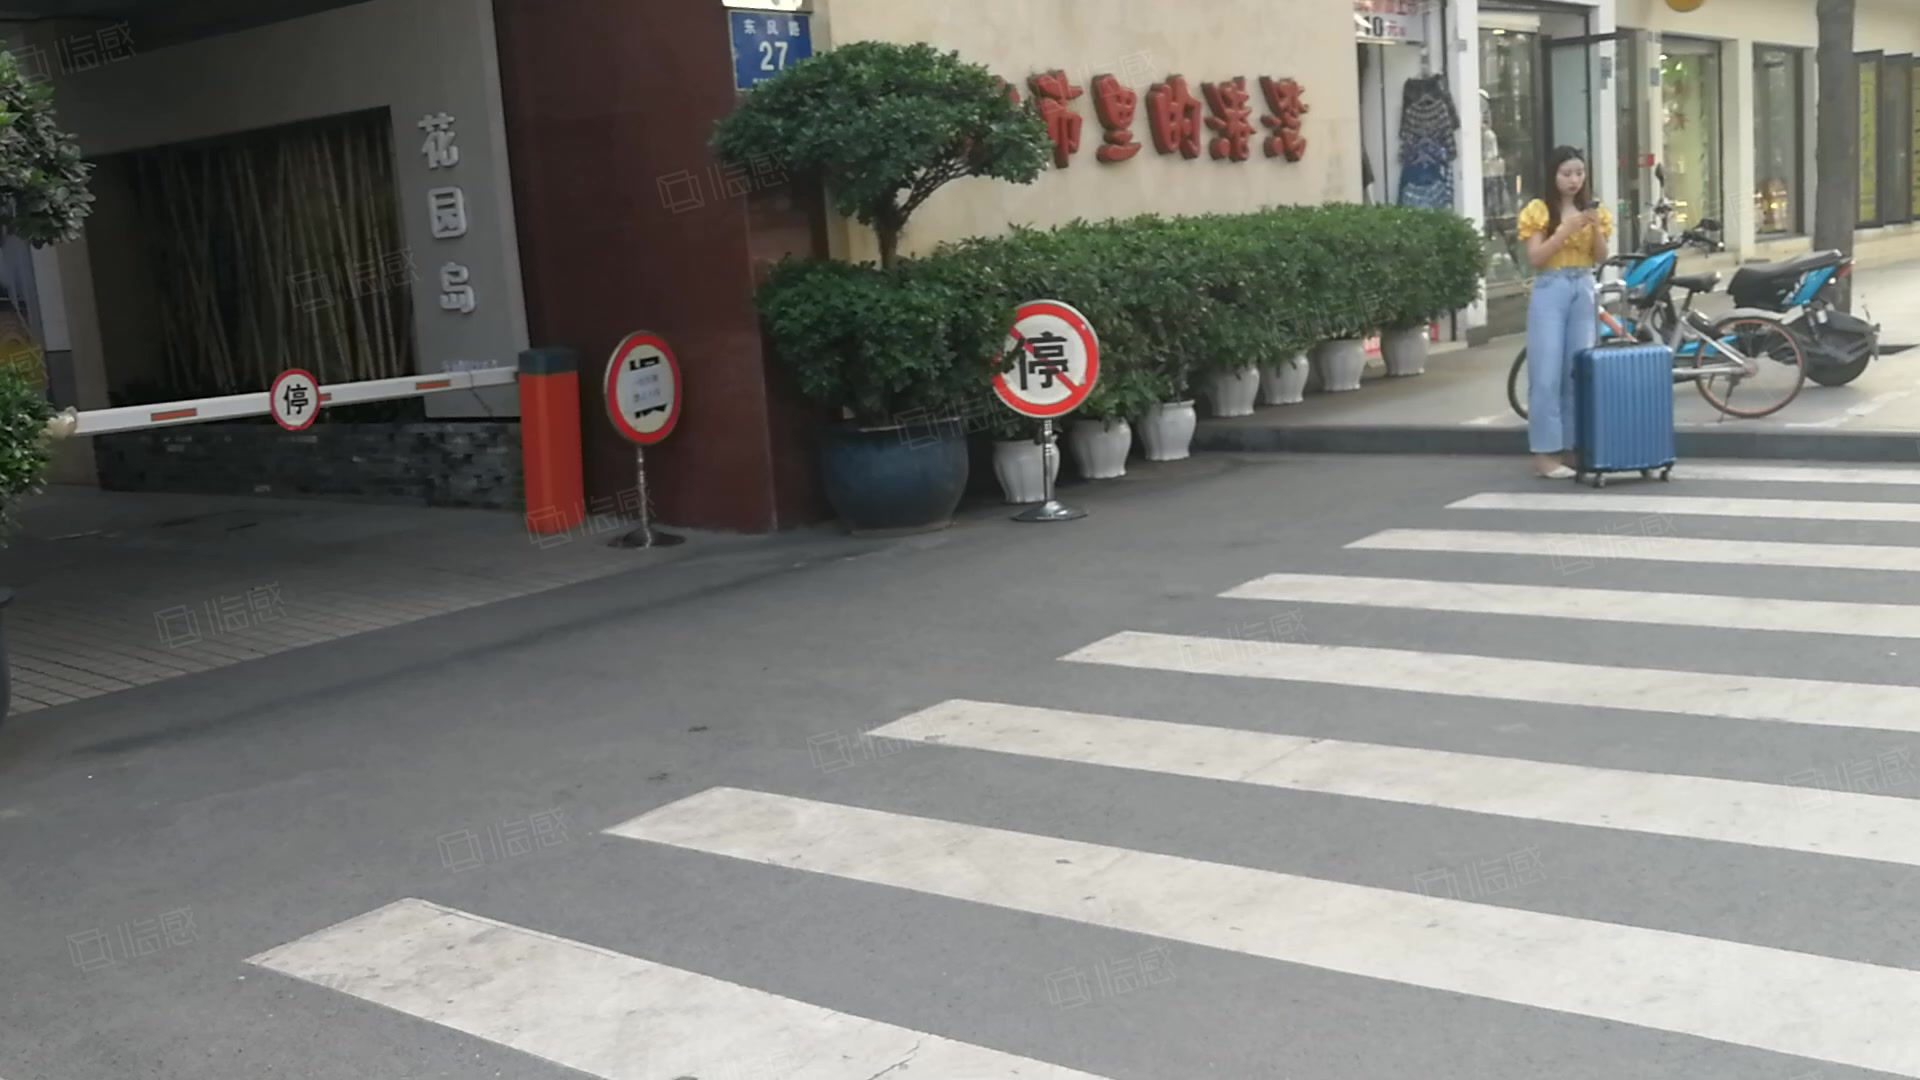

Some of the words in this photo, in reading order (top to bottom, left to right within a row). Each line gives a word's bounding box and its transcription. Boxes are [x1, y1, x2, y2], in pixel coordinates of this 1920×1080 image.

[758, 40, 789, 71] 27
[416, 111, 476, 315] 花园岛
[1008, 330, 1069, 391] 停
[282, 383, 309, 416] 停
